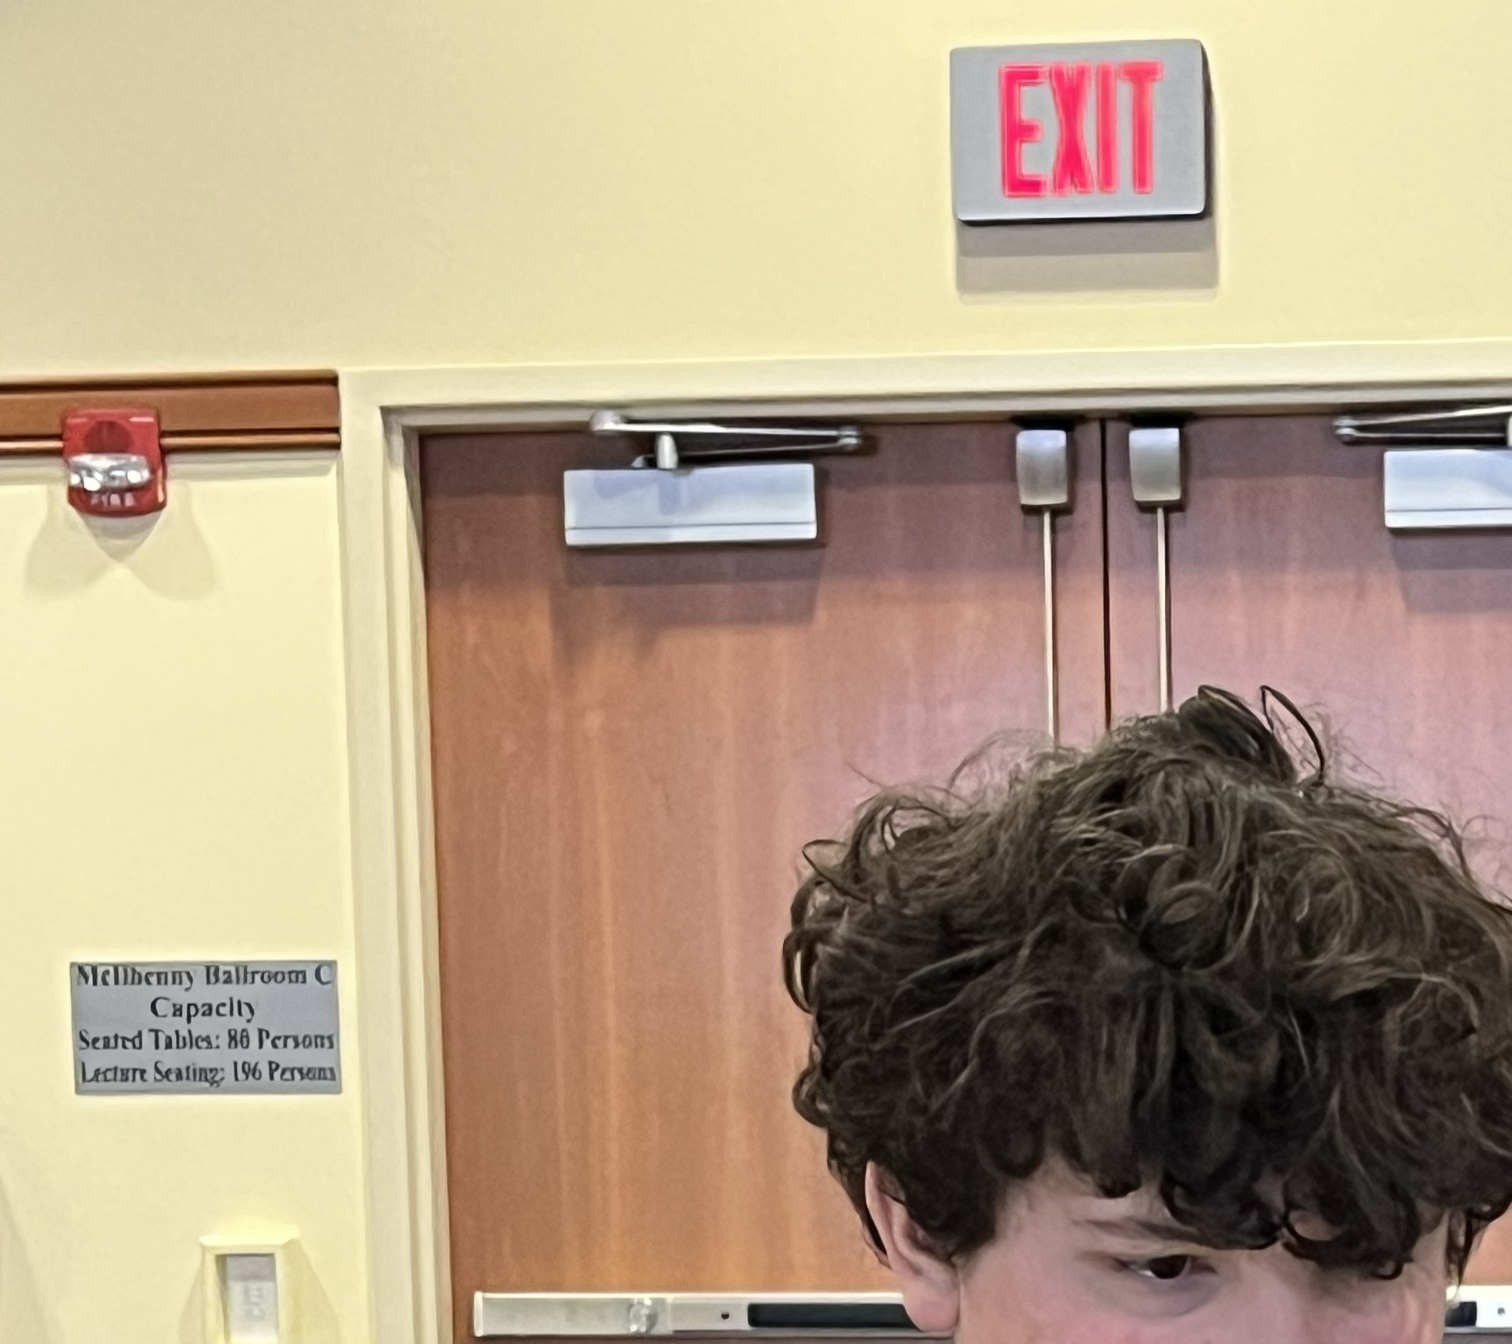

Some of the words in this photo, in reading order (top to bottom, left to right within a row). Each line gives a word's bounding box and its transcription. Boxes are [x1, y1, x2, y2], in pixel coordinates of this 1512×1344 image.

[999, 61, 1163, 197] EXIT
[205, 964, 307, 986] Ballroom
[314, 963, 333, 985] C
[150, 996, 256, 1024] Capacity
[78, 1029, 143, 1050] Seated
[149, 1028, 220, 1050] Tables:
[257, 1027, 335, 1050] Persons
[81, 1061, 148, 1083] Lecture
[153, 1060, 225, 1087] Seating:
[268, 1060, 337, 1082] Persons
